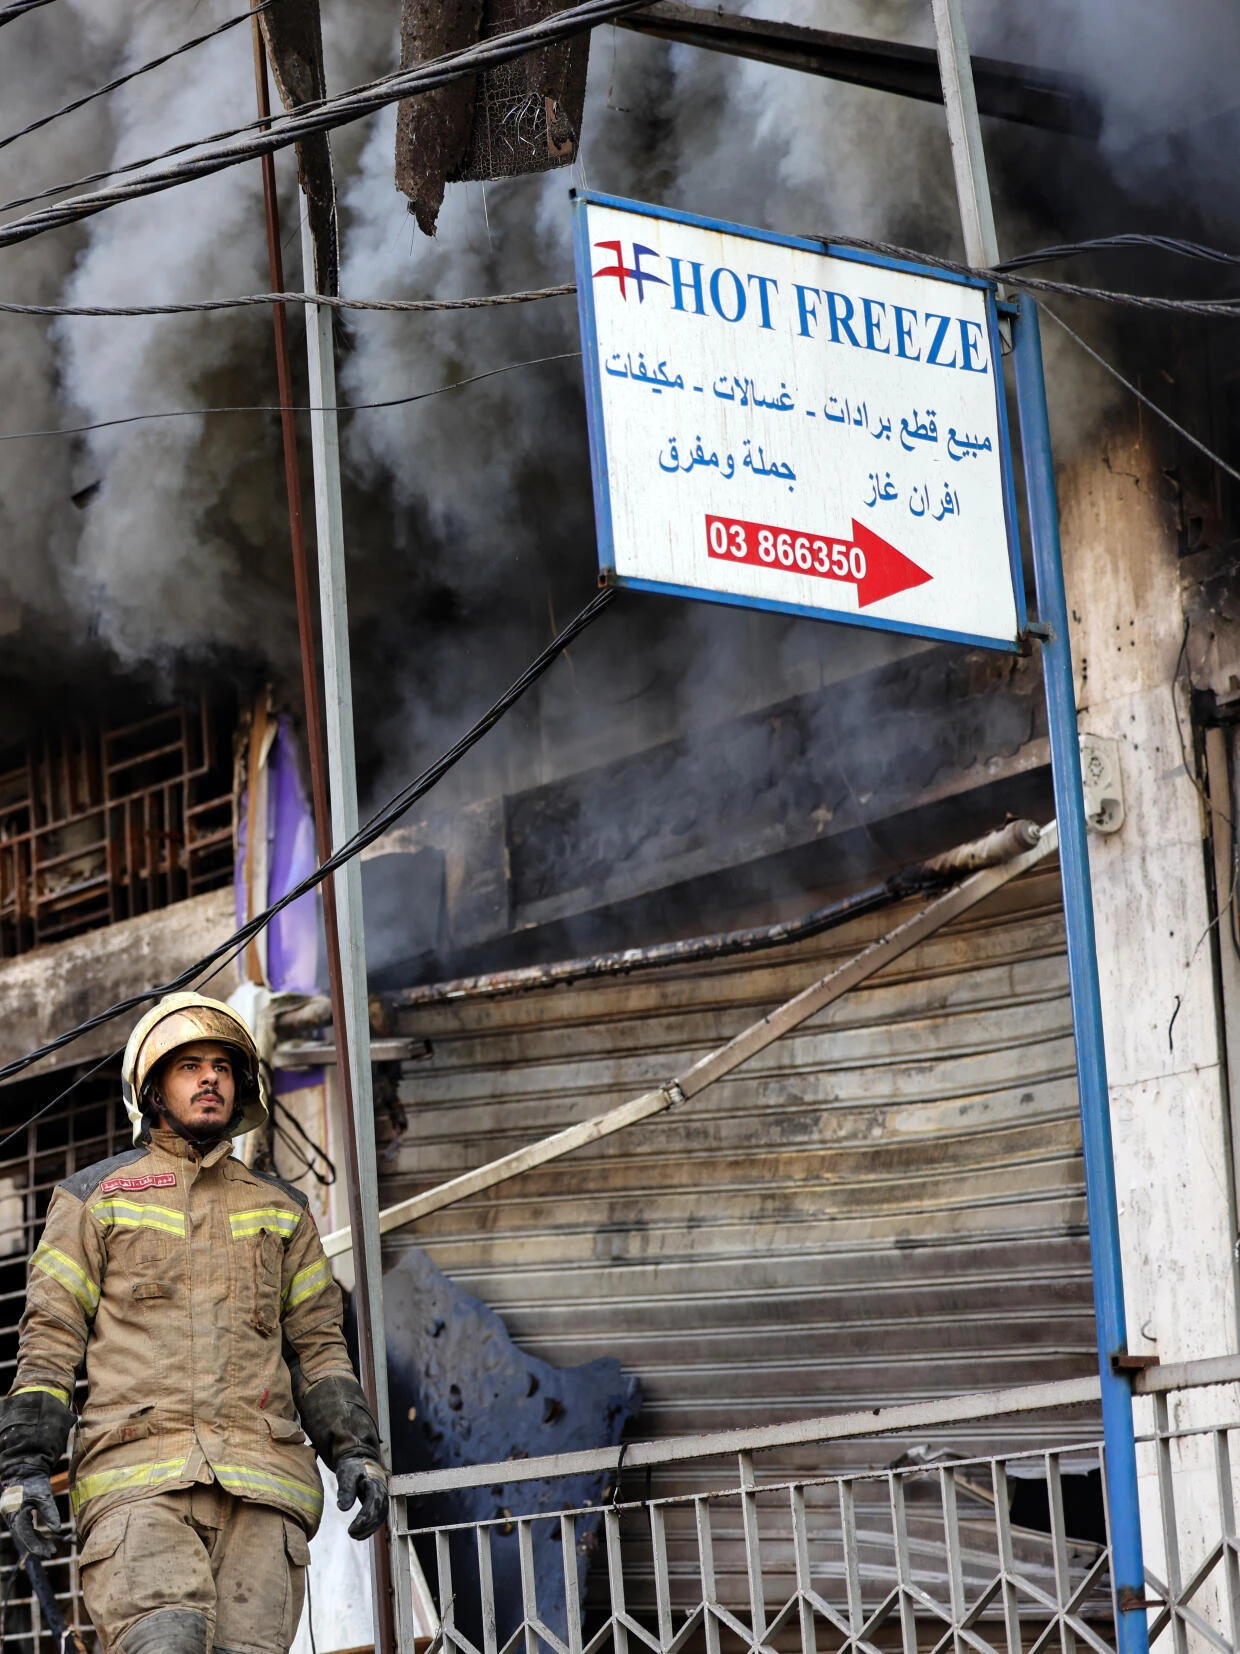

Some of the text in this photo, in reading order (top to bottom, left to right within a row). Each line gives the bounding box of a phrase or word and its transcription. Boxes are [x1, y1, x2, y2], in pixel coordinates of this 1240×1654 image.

[666, 256, 989, 375] HOT FREEZE
[605, 352, 685, 394] مكيفات
[713, 376, 795, 412] غسالات
[823, 396, 892, 441] برادات
[900, 408, 938, 452] قطع
[742, 439, 797, 493] جملة
[947, 427, 992, 462] مبيع
[863, 472, 960, 521] افران غاز
[709, 521, 868, 580] 03 866350
